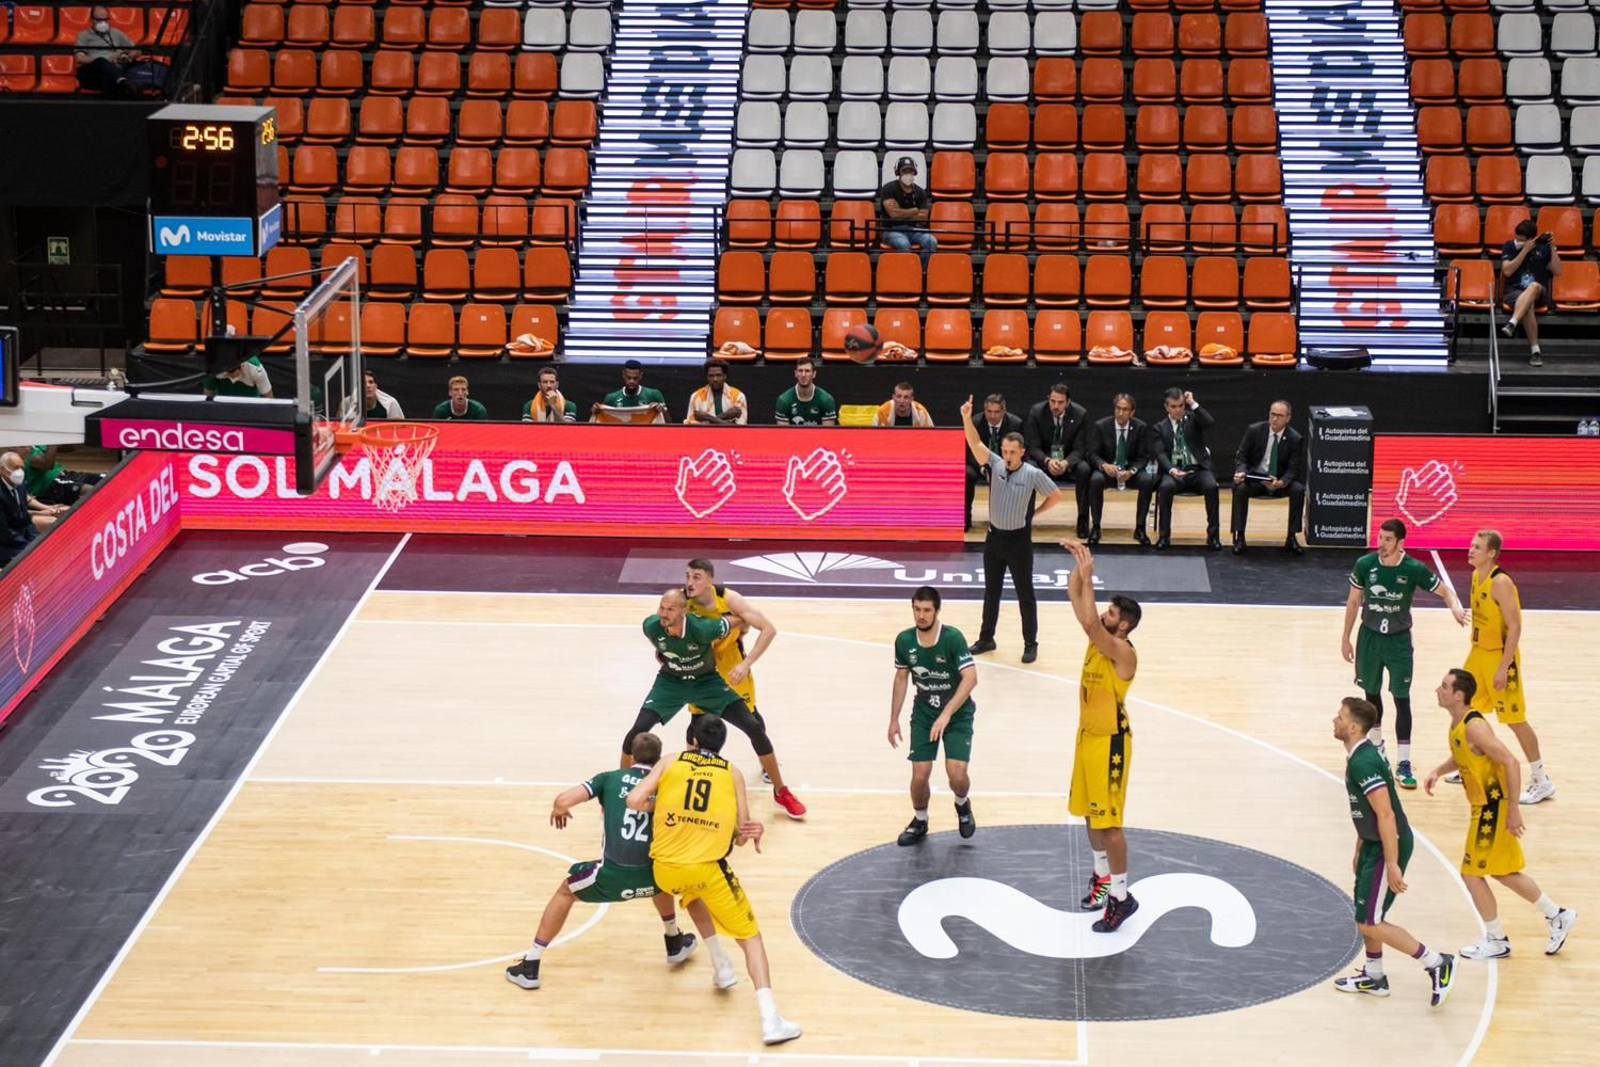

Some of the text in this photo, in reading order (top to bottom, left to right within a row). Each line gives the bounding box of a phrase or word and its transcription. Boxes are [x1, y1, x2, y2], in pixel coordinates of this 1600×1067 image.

[183, 126, 234, 150] 2:56
[196, 230, 247, 242] Movistar
[119, 423, 244, 451] endesa
[188, 443, 587, 504] SOL MÁLAGA
[91, 463, 179, 581] COSTA DEL
[191, 556, 326, 585] acb
[1380, 618, 1389, 634] 8
[90, 620, 242, 724] MÁLAGA
[174, 620, 272, 725] EUROPEAN CAPITAL OF SPORT
[26, 729, 197, 808] 2020
[684, 778, 712, 812] 19
[621, 808, 649, 842] 52
[677, 816, 720, 829] TENERIFE
